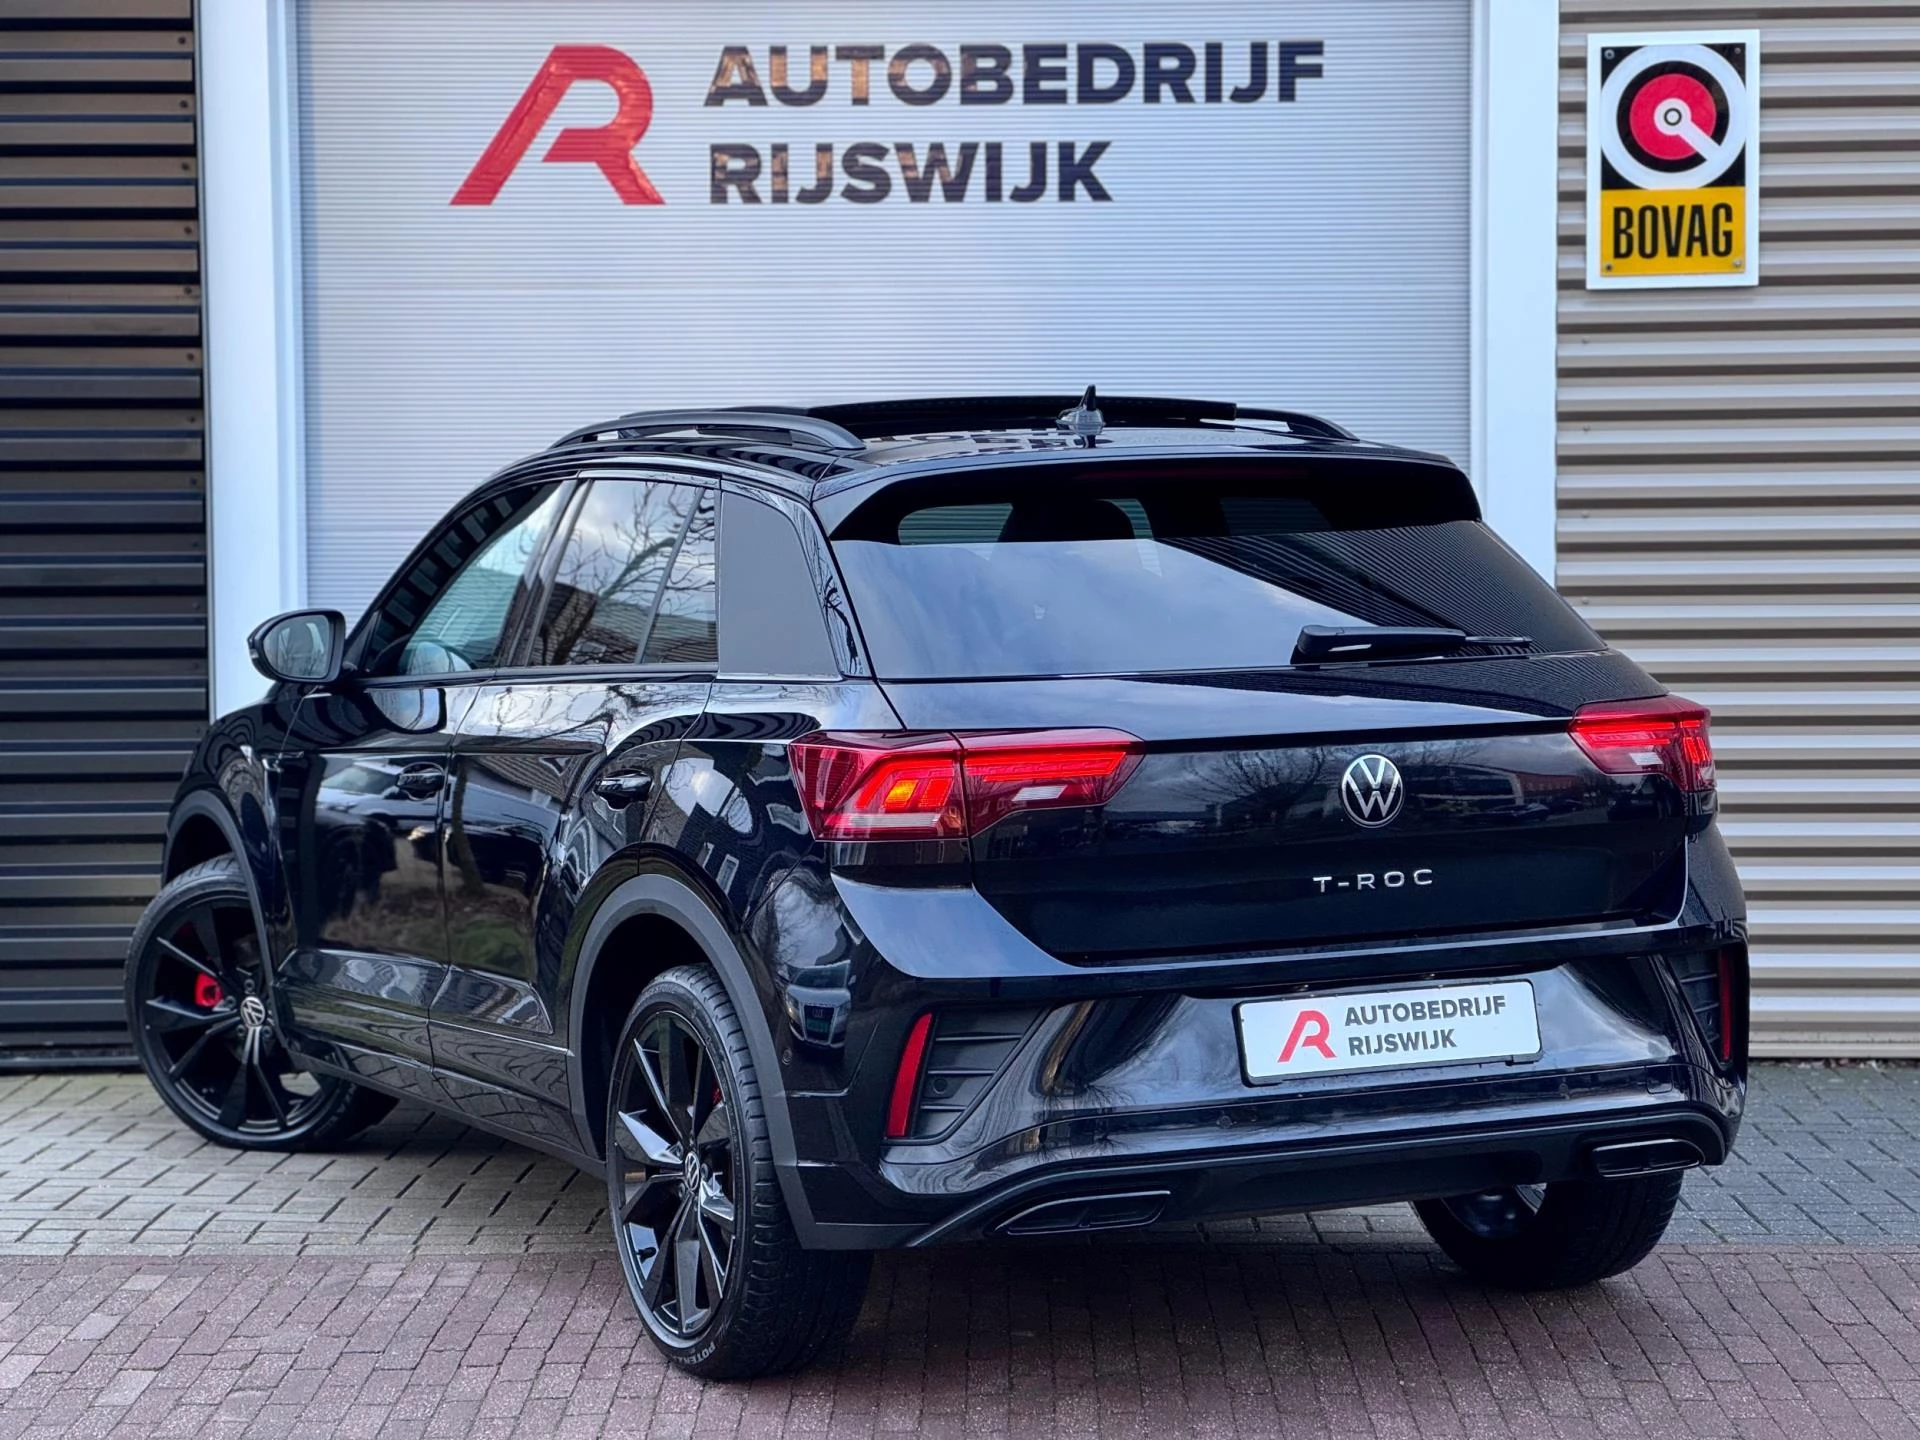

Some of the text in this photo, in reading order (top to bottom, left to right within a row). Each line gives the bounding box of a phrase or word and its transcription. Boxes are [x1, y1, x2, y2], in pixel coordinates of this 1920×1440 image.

[702, 40, 1325, 107] AUTOBEDRIJF
[709, 141, 1114, 204] RIJSWIJK
[1612, 202, 1734, 260] BOVAG
[1313, 868, 1433, 893] T-ROC
[1344, 995, 1507, 1027] AUTOBEDRIJF
[1348, 1028, 1458, 1057] RIJSWIJK
